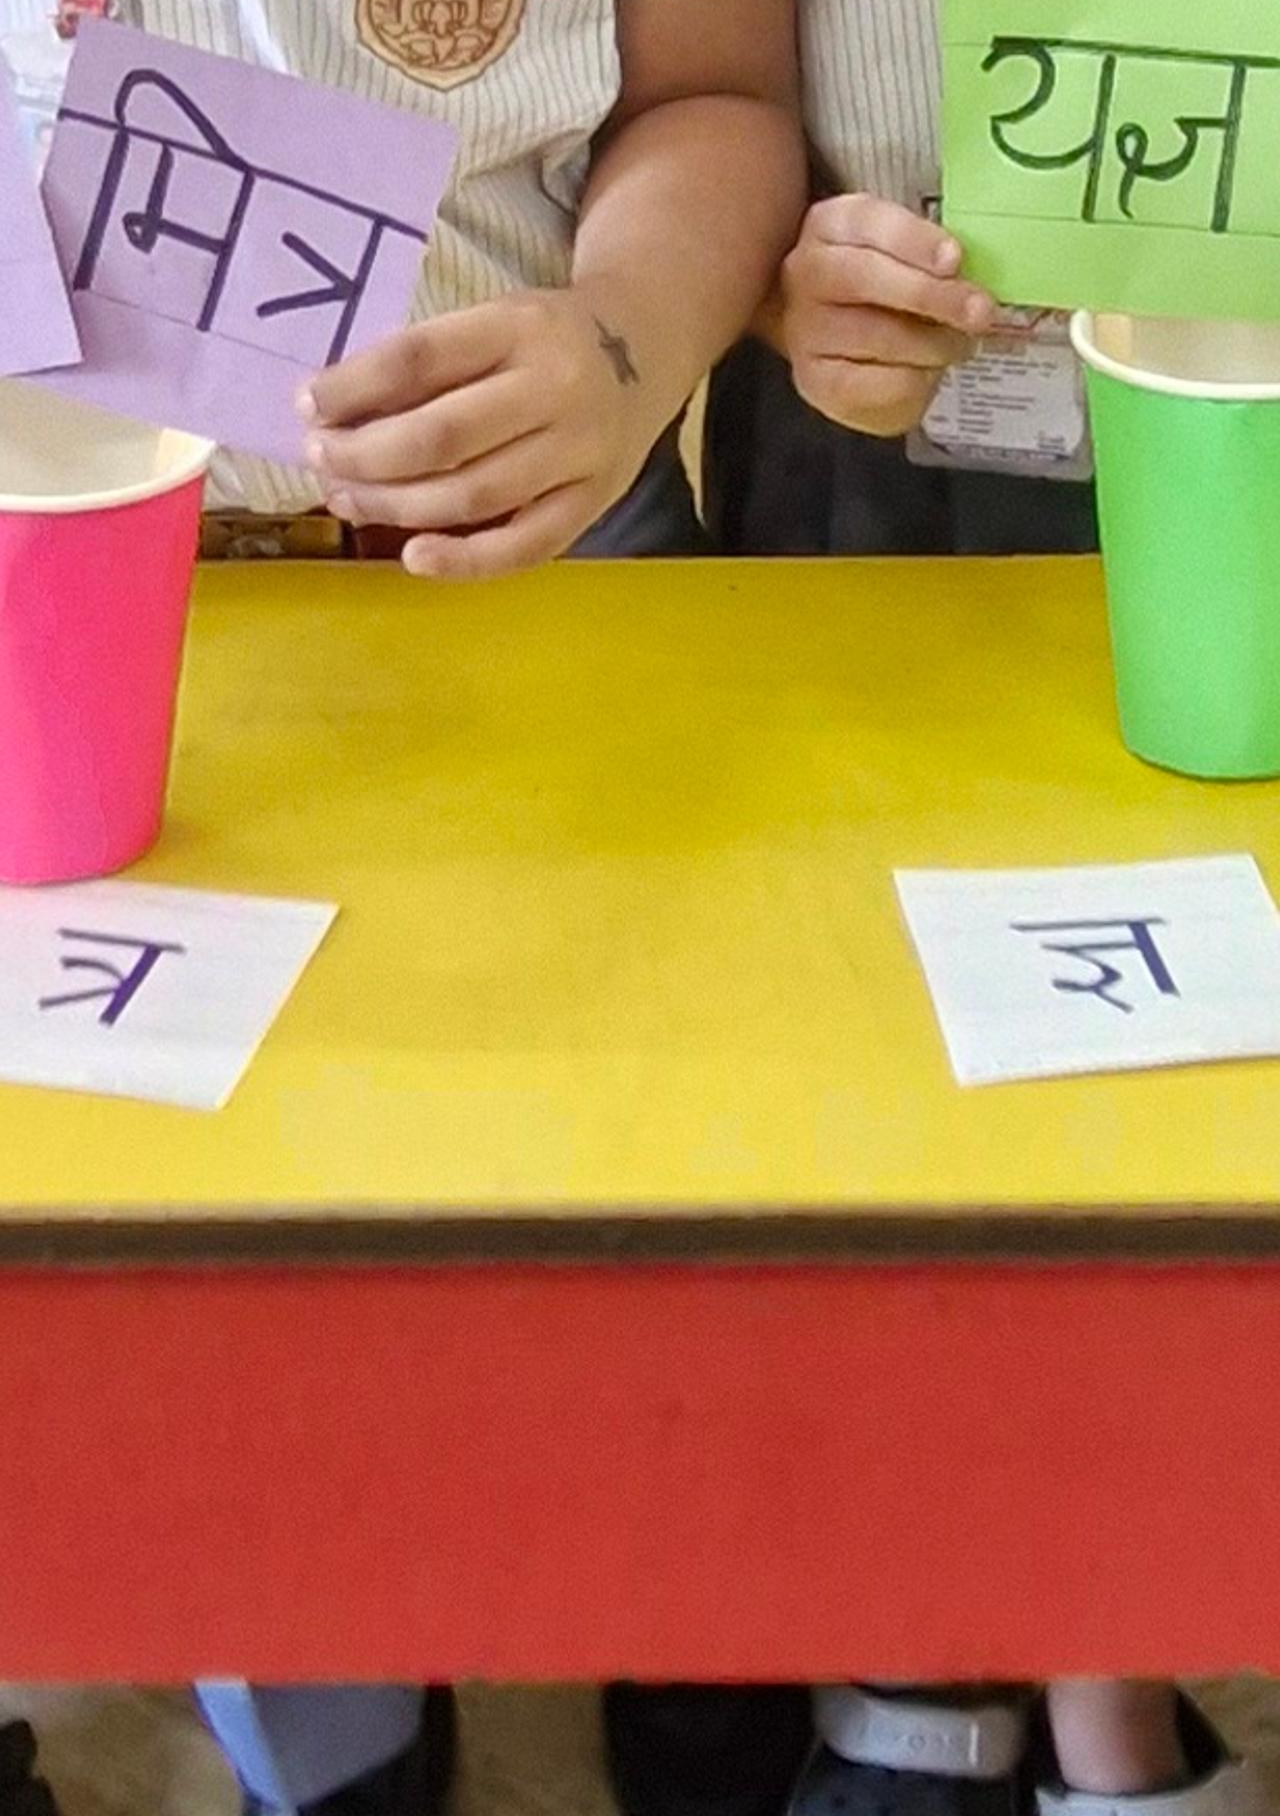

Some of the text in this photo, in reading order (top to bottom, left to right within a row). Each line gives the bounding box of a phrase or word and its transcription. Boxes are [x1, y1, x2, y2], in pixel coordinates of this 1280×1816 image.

[56, 68, 427, 366] मित्र
[38, 927, 186, 1028] त्र
[1009, 916, 1181, 1014] ज्ञ
